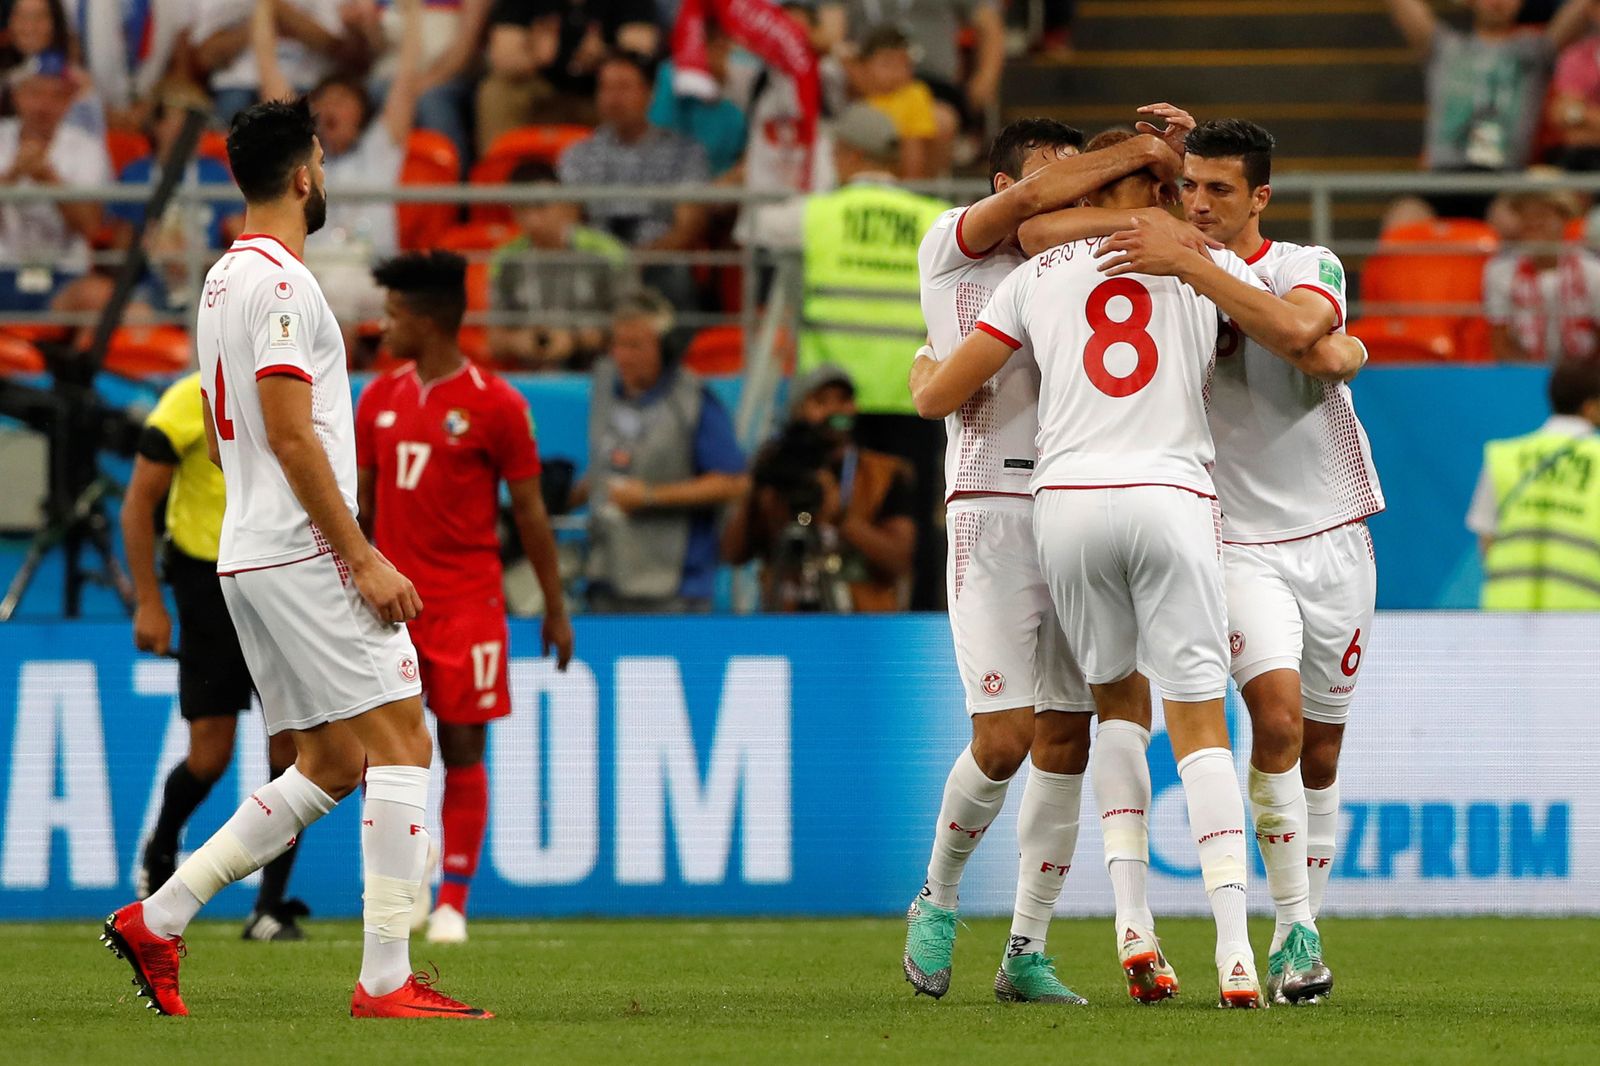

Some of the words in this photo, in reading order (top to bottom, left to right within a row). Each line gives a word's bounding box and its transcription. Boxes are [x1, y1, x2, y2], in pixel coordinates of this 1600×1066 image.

[1083, 276, 1159, 398] 8
[396, 441, 433, 491] 17
[1341, 628, 1362, 677] 6
[471, 640, 502, 691] 17
[1102, 808, 1145, 819] uhlsport
[949, 821, 989, 839] FT
[1198, 828, 1243, 845] uhlsport
[1039, 861, 1071, 877] FT
[1306, 856, 1331, 869] TF
